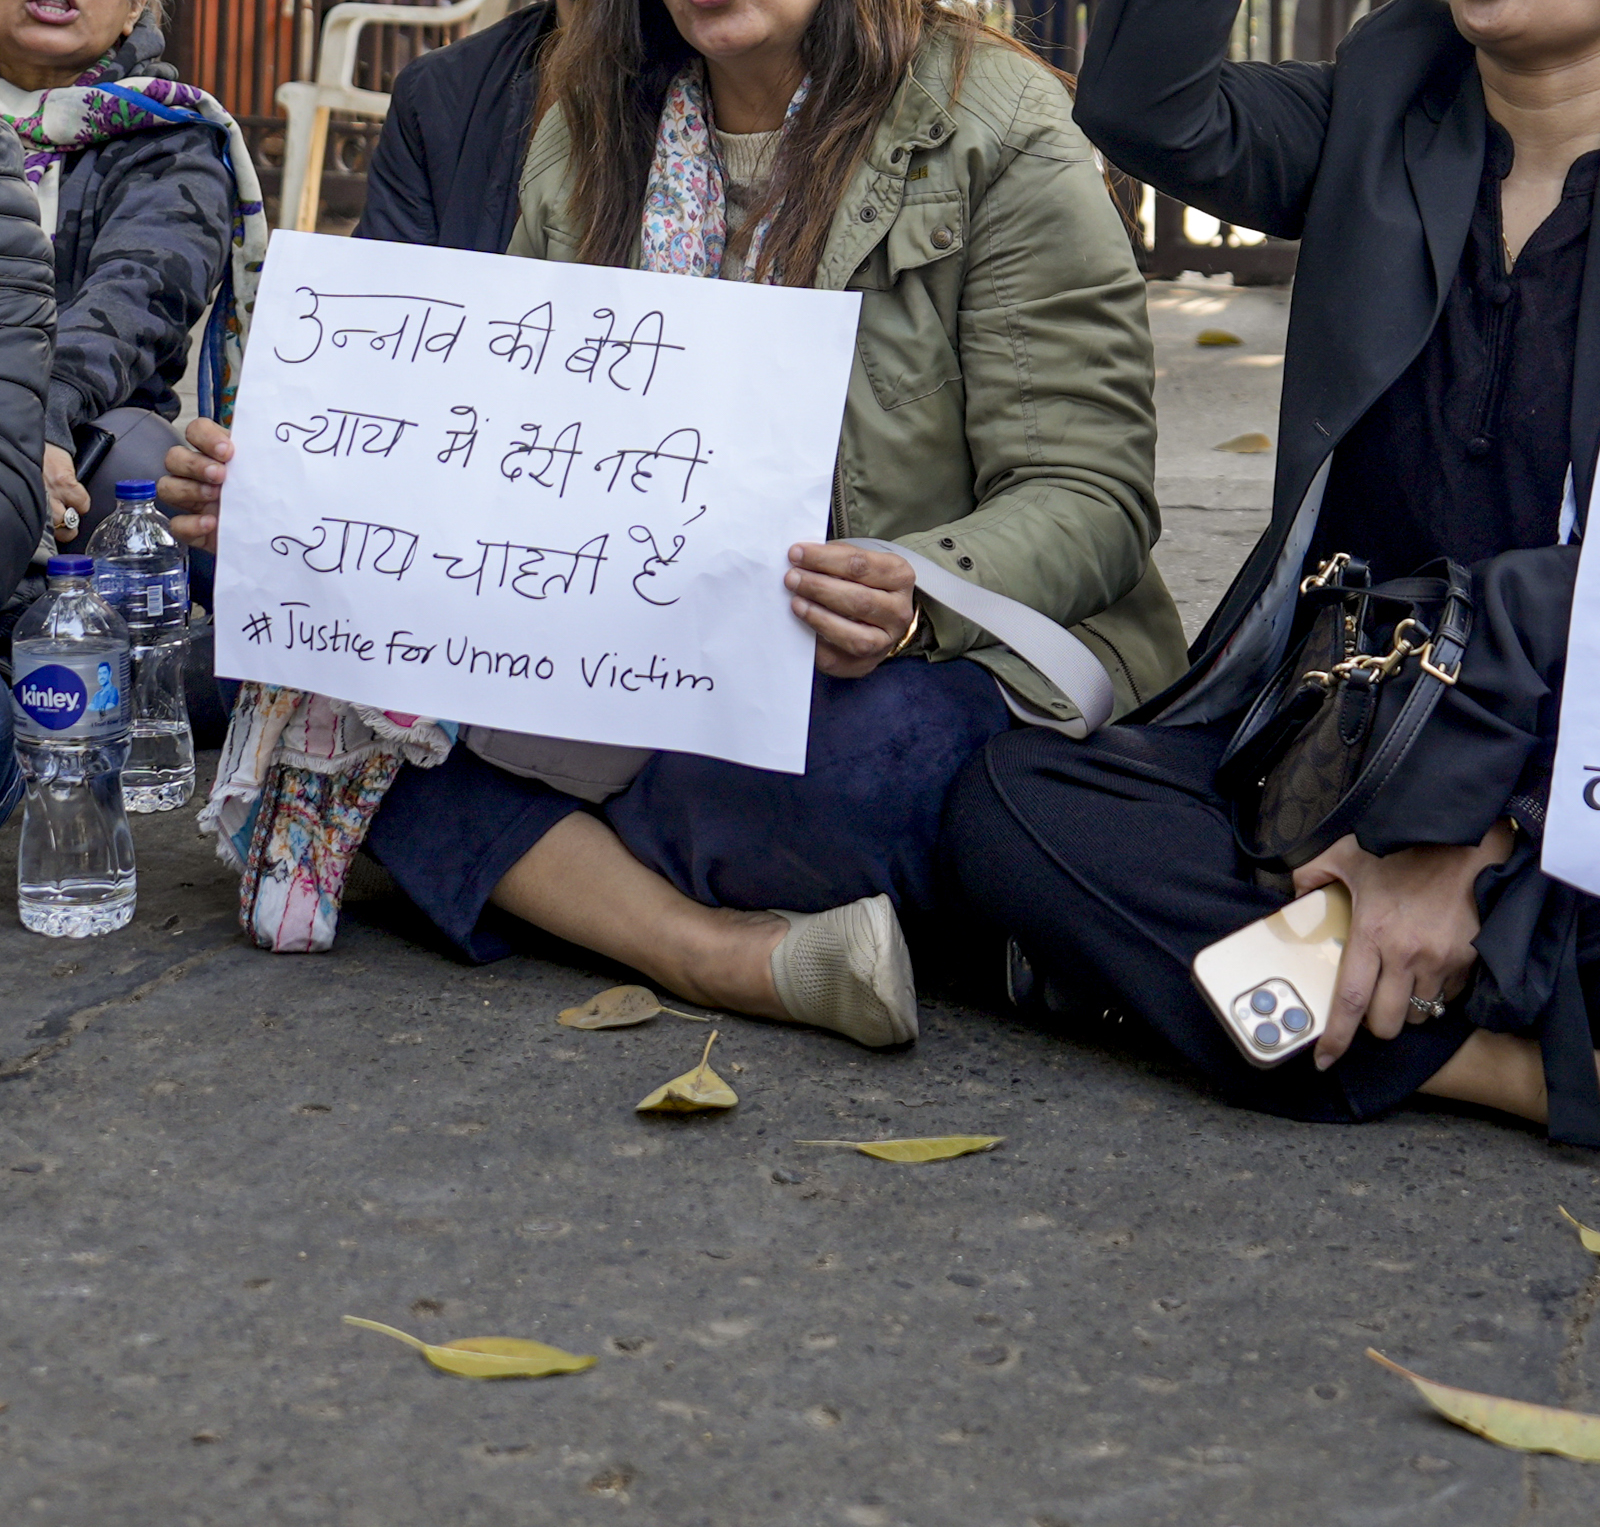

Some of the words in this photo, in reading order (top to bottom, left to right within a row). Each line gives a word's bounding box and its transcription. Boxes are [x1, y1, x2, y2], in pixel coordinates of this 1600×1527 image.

[272, 286, 466, 364] उन्नाव
[487, 300, 556, 375] की
[274, 407, 419, 459] न्याय
[500, 421, 584, 499] देरी
[270, 516, 420, 581] न्याय
[432, 533, 610, 597] चाहती
[21, 683, 80, 712] kinley
[445, 635, 555, 680] Unnao
[581, 651, 715, 692] Victim
